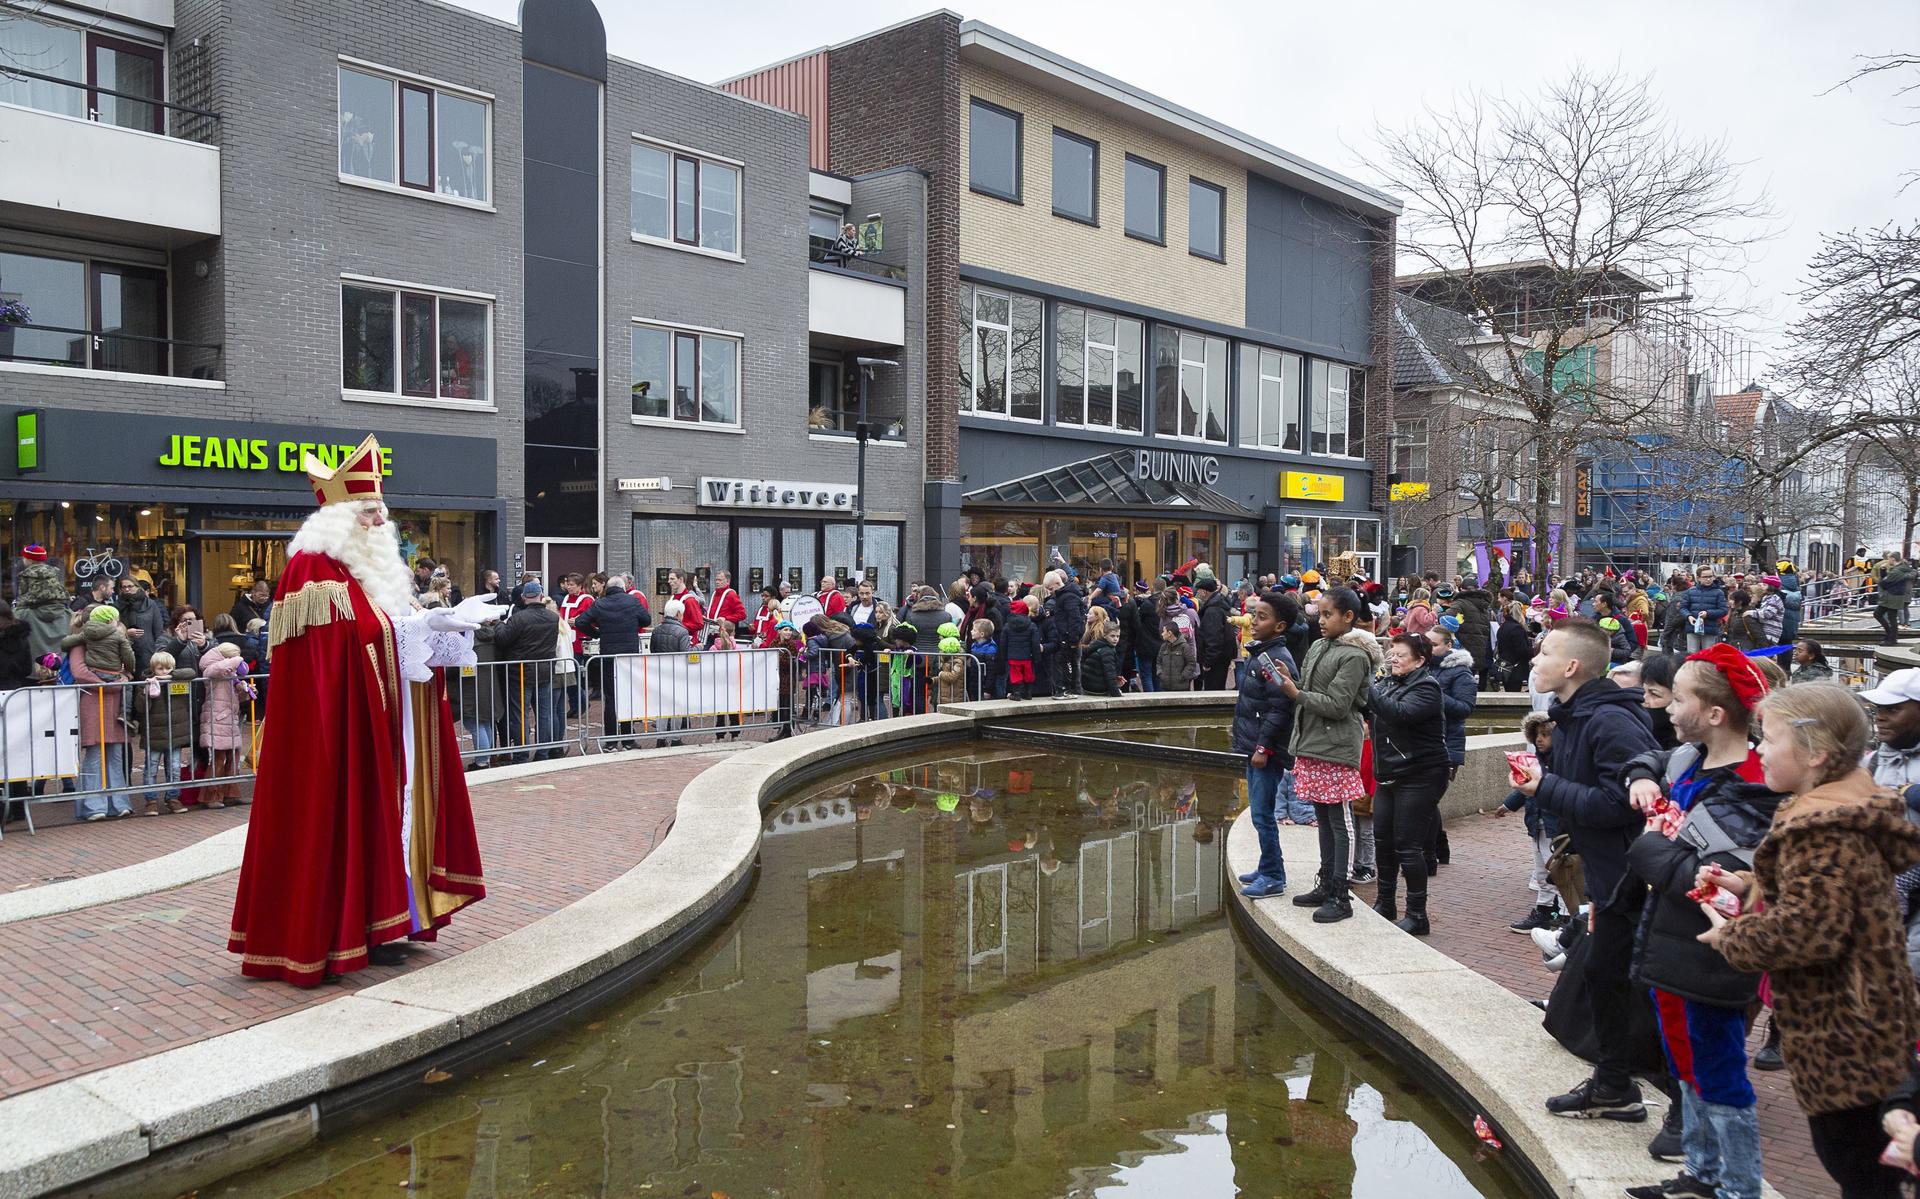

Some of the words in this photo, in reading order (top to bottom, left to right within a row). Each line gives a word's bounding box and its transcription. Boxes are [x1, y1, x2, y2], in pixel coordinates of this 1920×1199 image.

[160, 434, 268, 470] JEANS
[278, 441, 392, 476] CENTE
[1138, 449, 1220, 485] BUINING
[1577, 469, 1587, 516] OKAY
